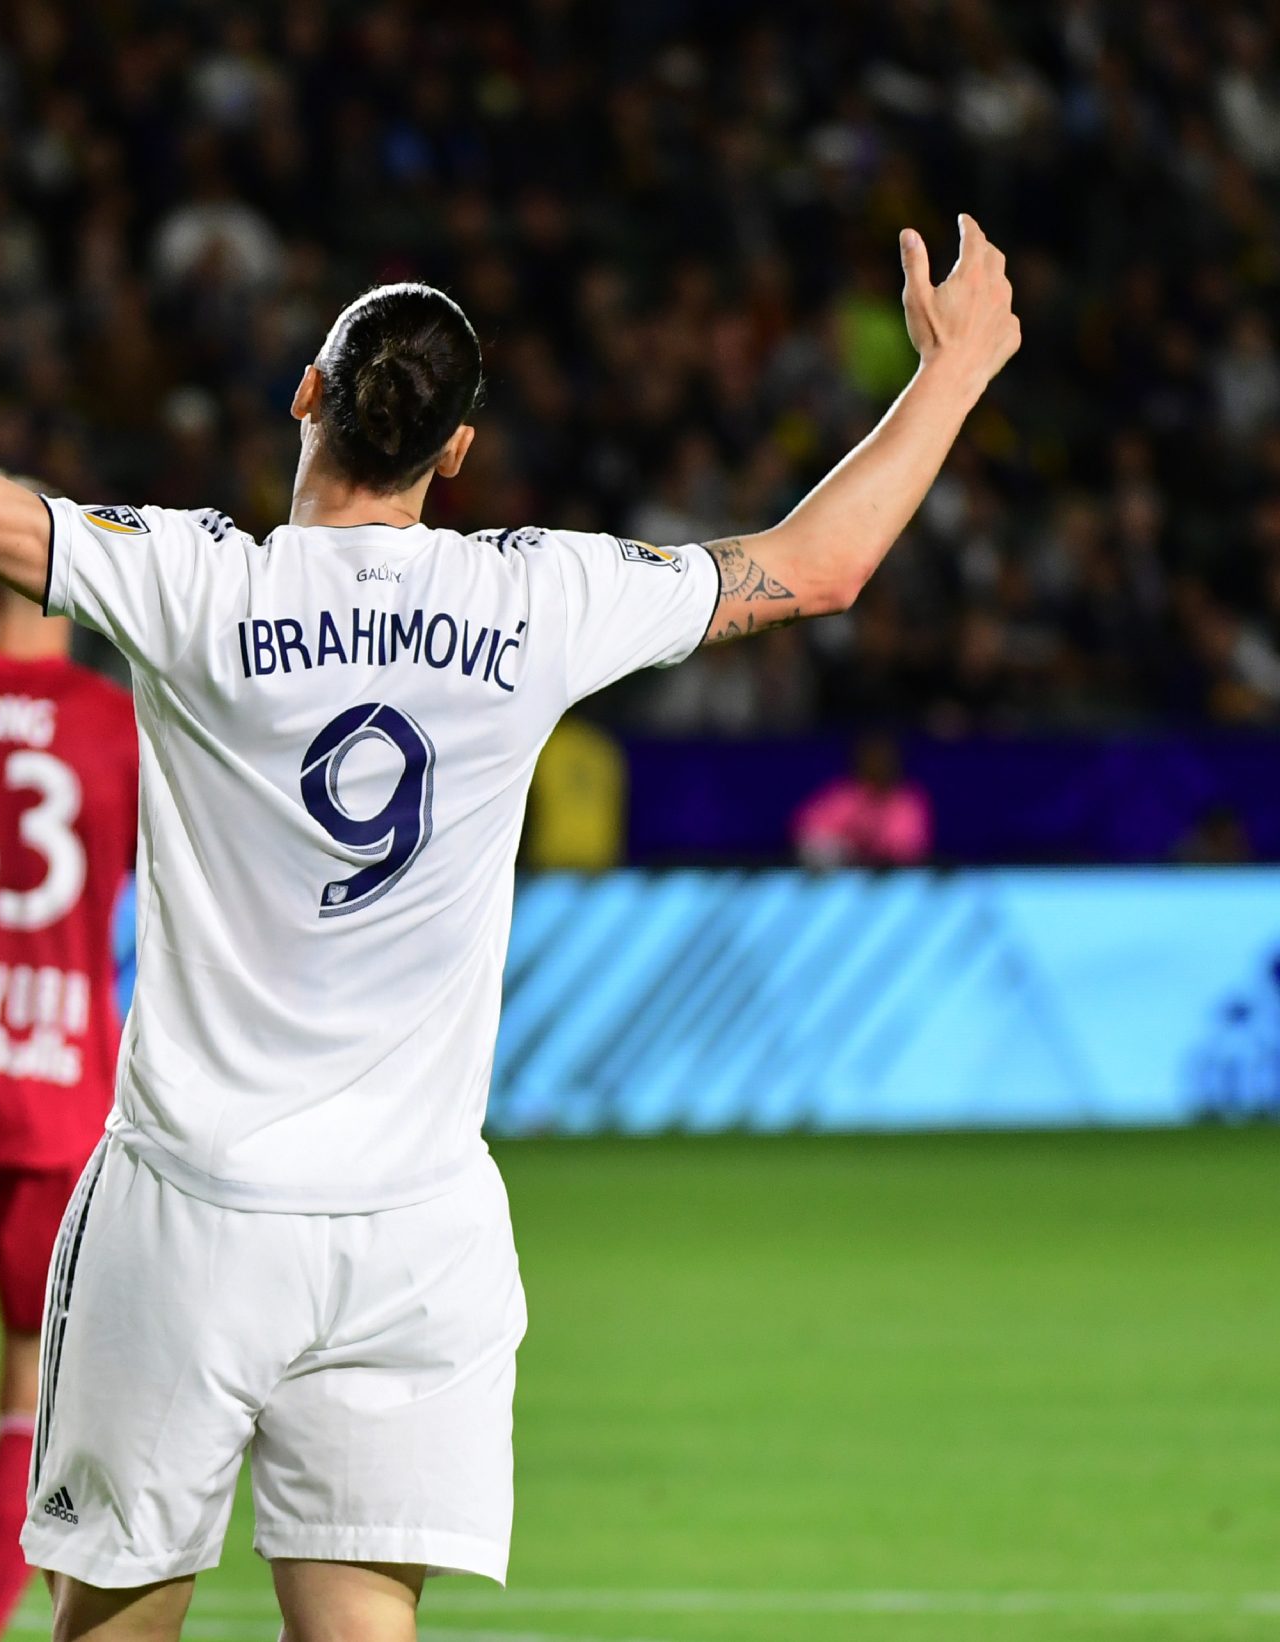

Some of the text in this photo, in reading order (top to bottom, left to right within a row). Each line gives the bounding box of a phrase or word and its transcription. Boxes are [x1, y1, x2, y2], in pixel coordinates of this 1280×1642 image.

[238, 608, 526, 694] IBRAHIMOVIĆ
[299, 701, 436, 919] 9
[44, 1503, 79, 1525] adidas
